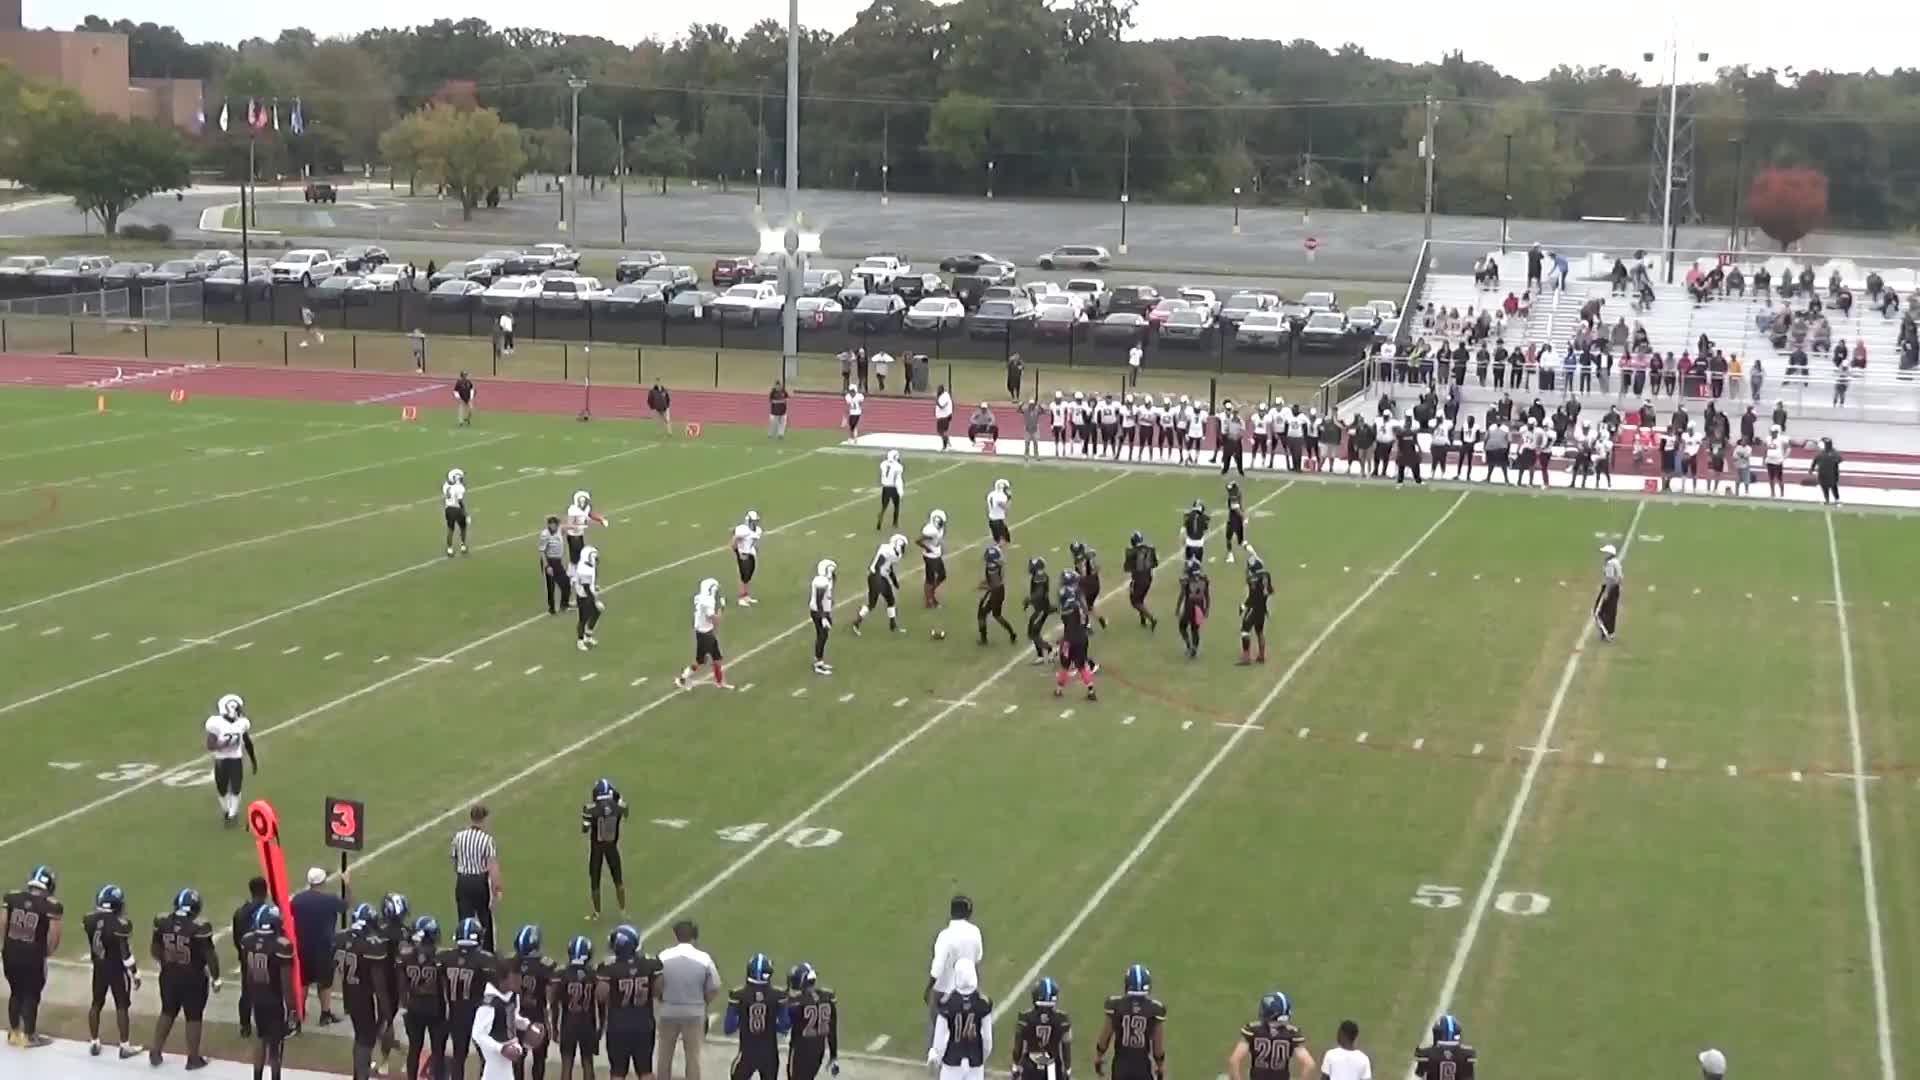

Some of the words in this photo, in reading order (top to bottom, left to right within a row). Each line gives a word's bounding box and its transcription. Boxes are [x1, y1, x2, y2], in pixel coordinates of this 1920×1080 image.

[331, 803, 355, 836] 3
[714, 822, 843, 848] 40
[1410, 884, 1551, 915] 50
[618, 976, 649, 1008] 75
[749, 1002, 767, 1033] 8
[954, 1013, 977, 1043] 14
[1121, 1014, 1147, 1049] 13
[1036, 1025, 1052, 1049] 7
[1254, 1037, 1290, 1070] 20
